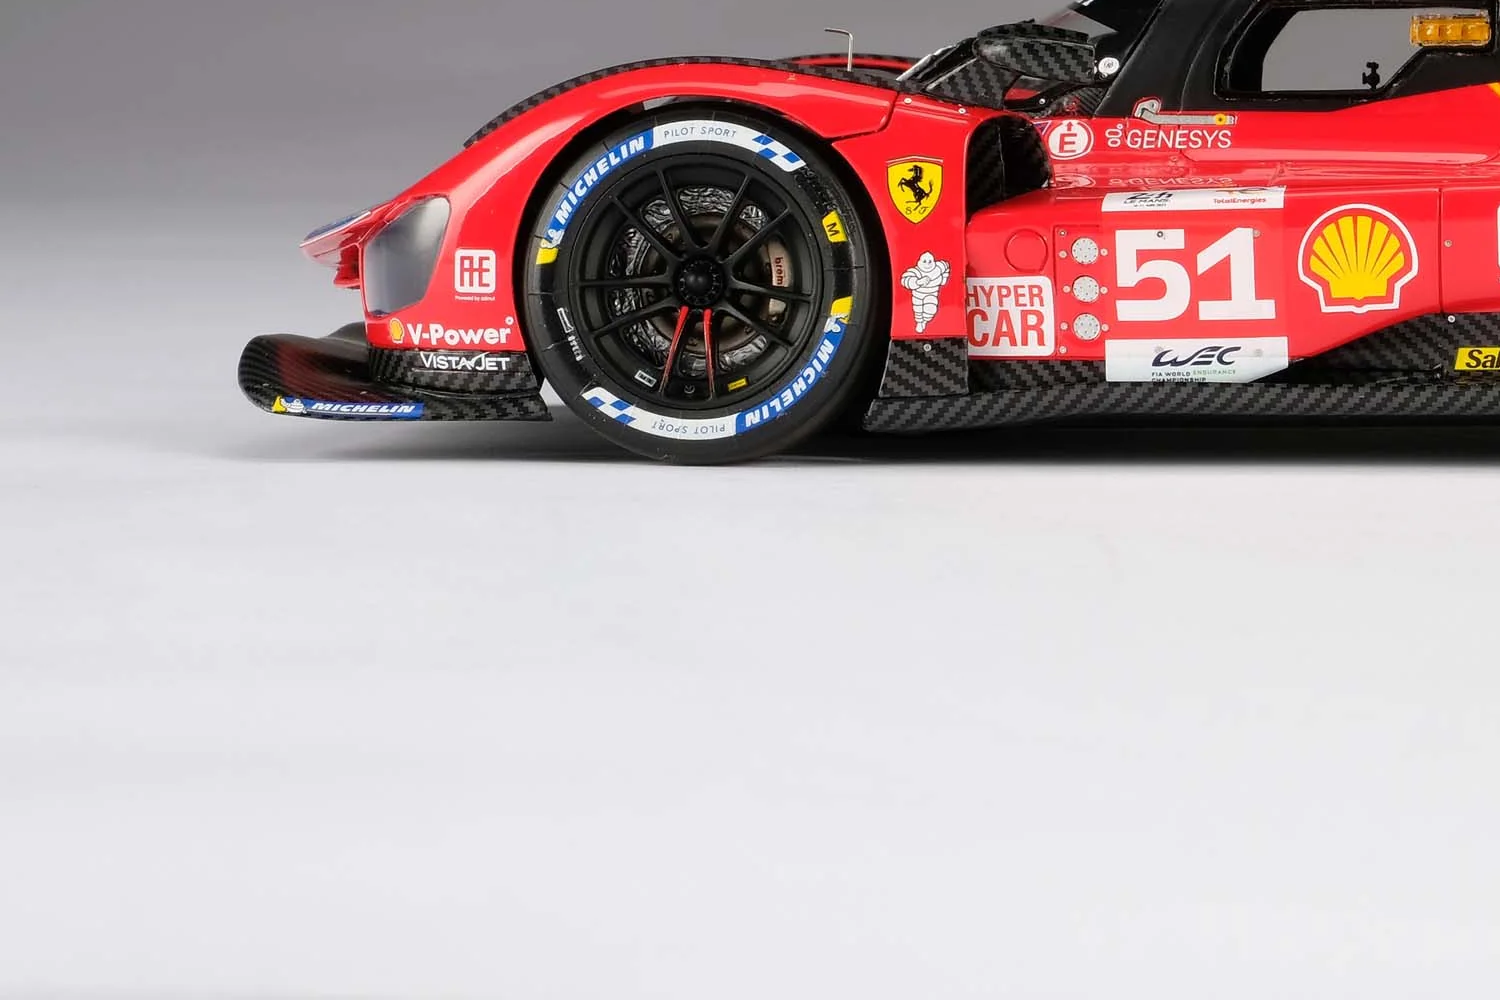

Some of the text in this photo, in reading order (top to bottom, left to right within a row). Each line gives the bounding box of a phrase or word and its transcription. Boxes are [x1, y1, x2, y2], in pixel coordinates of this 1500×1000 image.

[664, 126, 737, 139] PILOT SPORT
[1126, 130, 1232, 149] GENESYS
[555, 135, 645, 226] MICHELIN
[827, 222, 840, 237] M
[1115, 227, 1276, 322] 51
[965, 285, 1045, 308] HYPER
[406, 323, 511, 346] V-Power
[967, 308, 1046, 347] CAR
[420, 351, 511, 371] VISTAJET
[1151, 345, 1242, 367] WEC
[745, 339, 834, 428] MICHELIN
[311, 402, 416, 413] MICHELIN
[652, 421, 726, 435] PILOT SPORT
